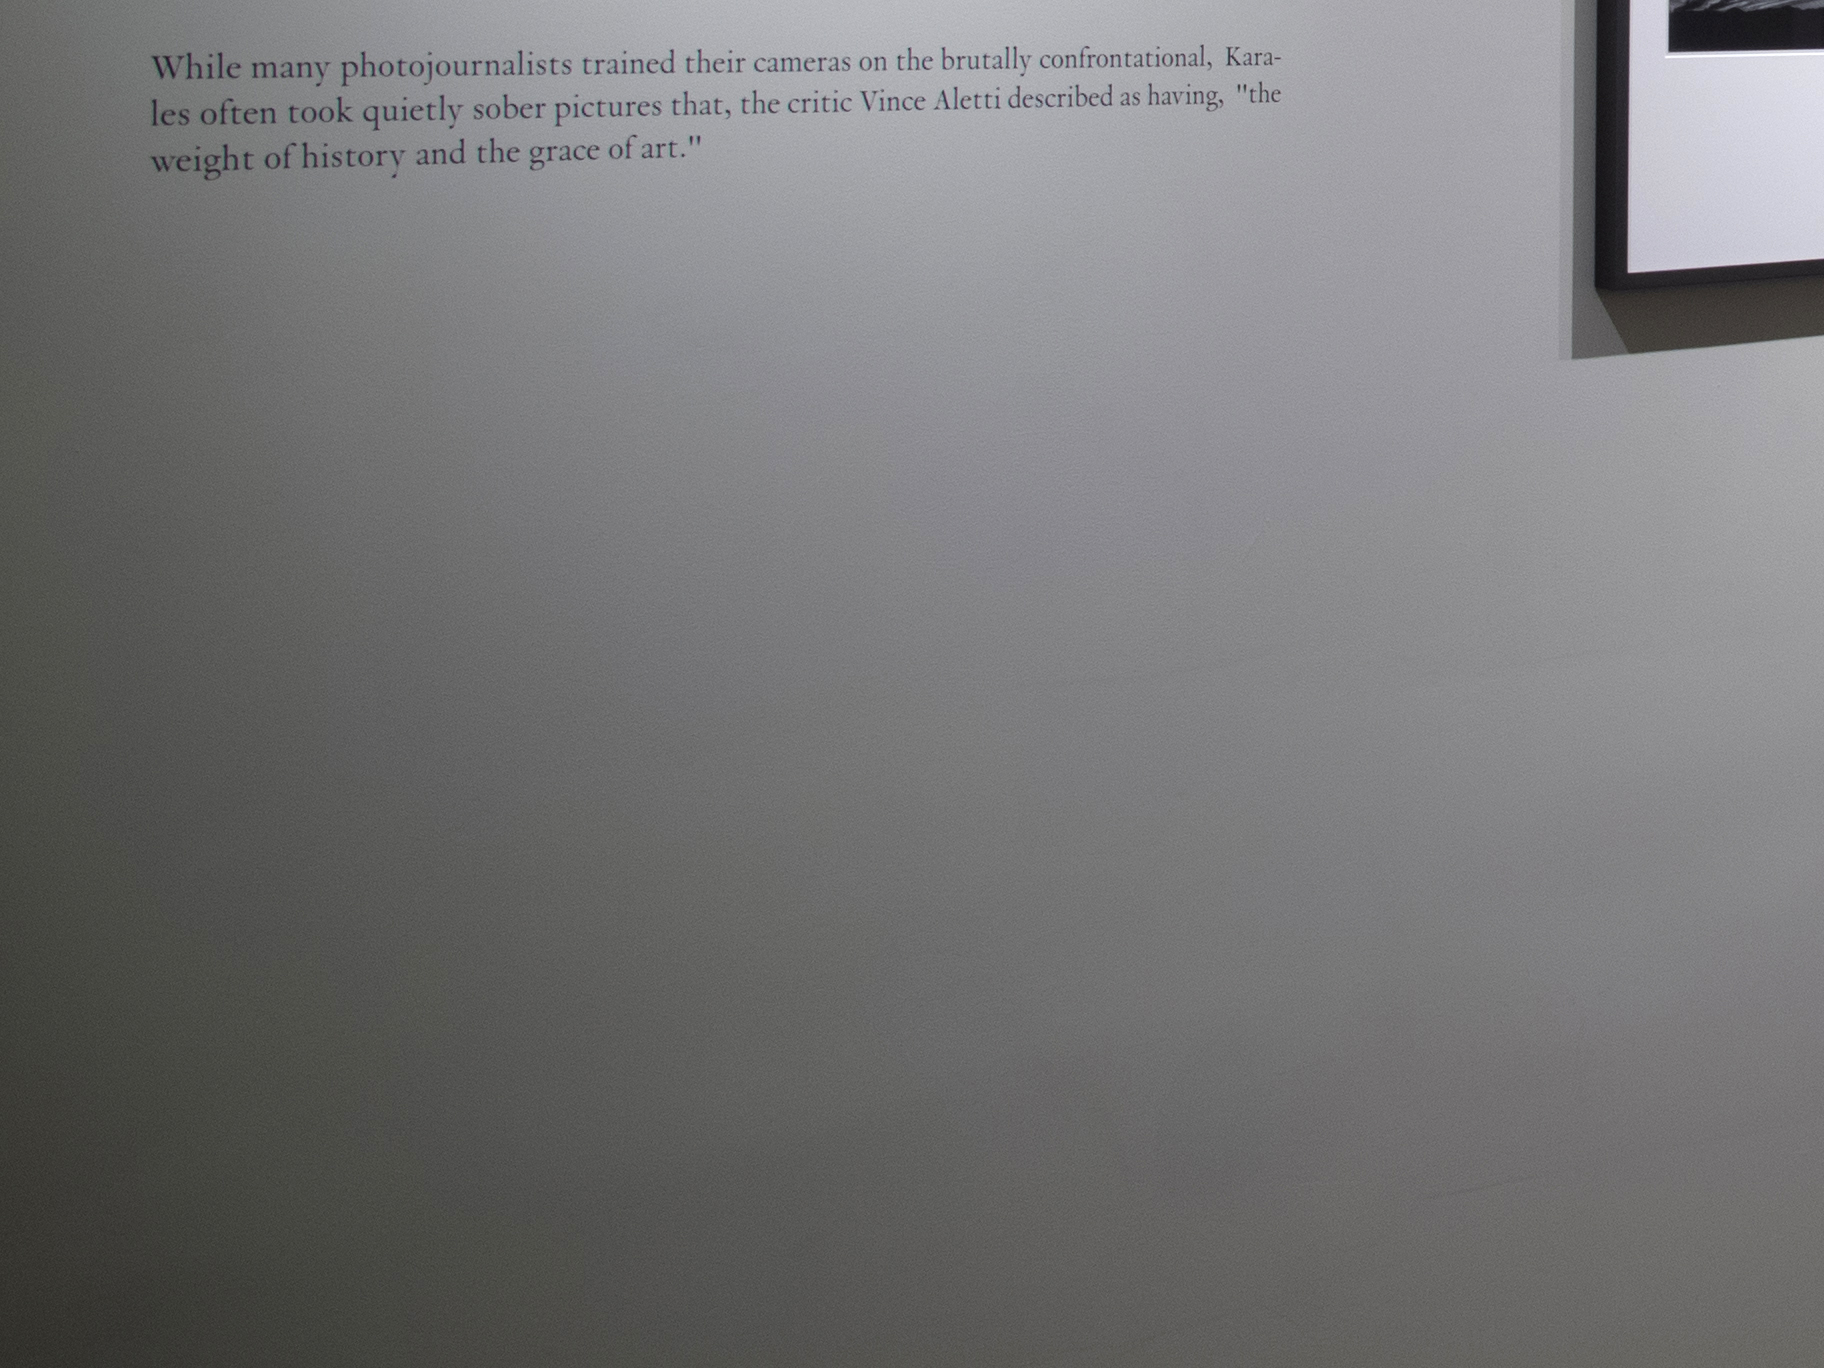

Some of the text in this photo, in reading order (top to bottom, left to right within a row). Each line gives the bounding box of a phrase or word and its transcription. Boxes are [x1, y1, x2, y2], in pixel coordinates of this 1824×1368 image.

[151, 44, 1281, 87] While many photojournalists trained their cameras on the brutally confrontational, Kara-
[151, 99, 190, 126] les
[200, 98, 276, 125] often
[289, 96, 353, 124] took
[363, 94, 463, 131] quietly
[474, 94, 546, 120] sober
[555, 94, 662, 127] pictures
[672, 91, 731, 119] that,
[741, 90, 780, 114] the
[788, 90, 852, 113] critic
[860, 89, 926, 112] Vince
[934, 86, 1001, 110] Aletti
[1008, 84, 1113, 109] described
[1120, 92, 1140, 106] as
[1148, 83, 1224, 112] having,
[151, 143, 254, 181] weight
[264, 142, 297, 169] of
[302, 142, 405, 179] history
[416, 138, 465, 165] and
[477, 137, 520, 164] the
[530, 145, 600, 171] grace
[608, 134, 638, 159] of
